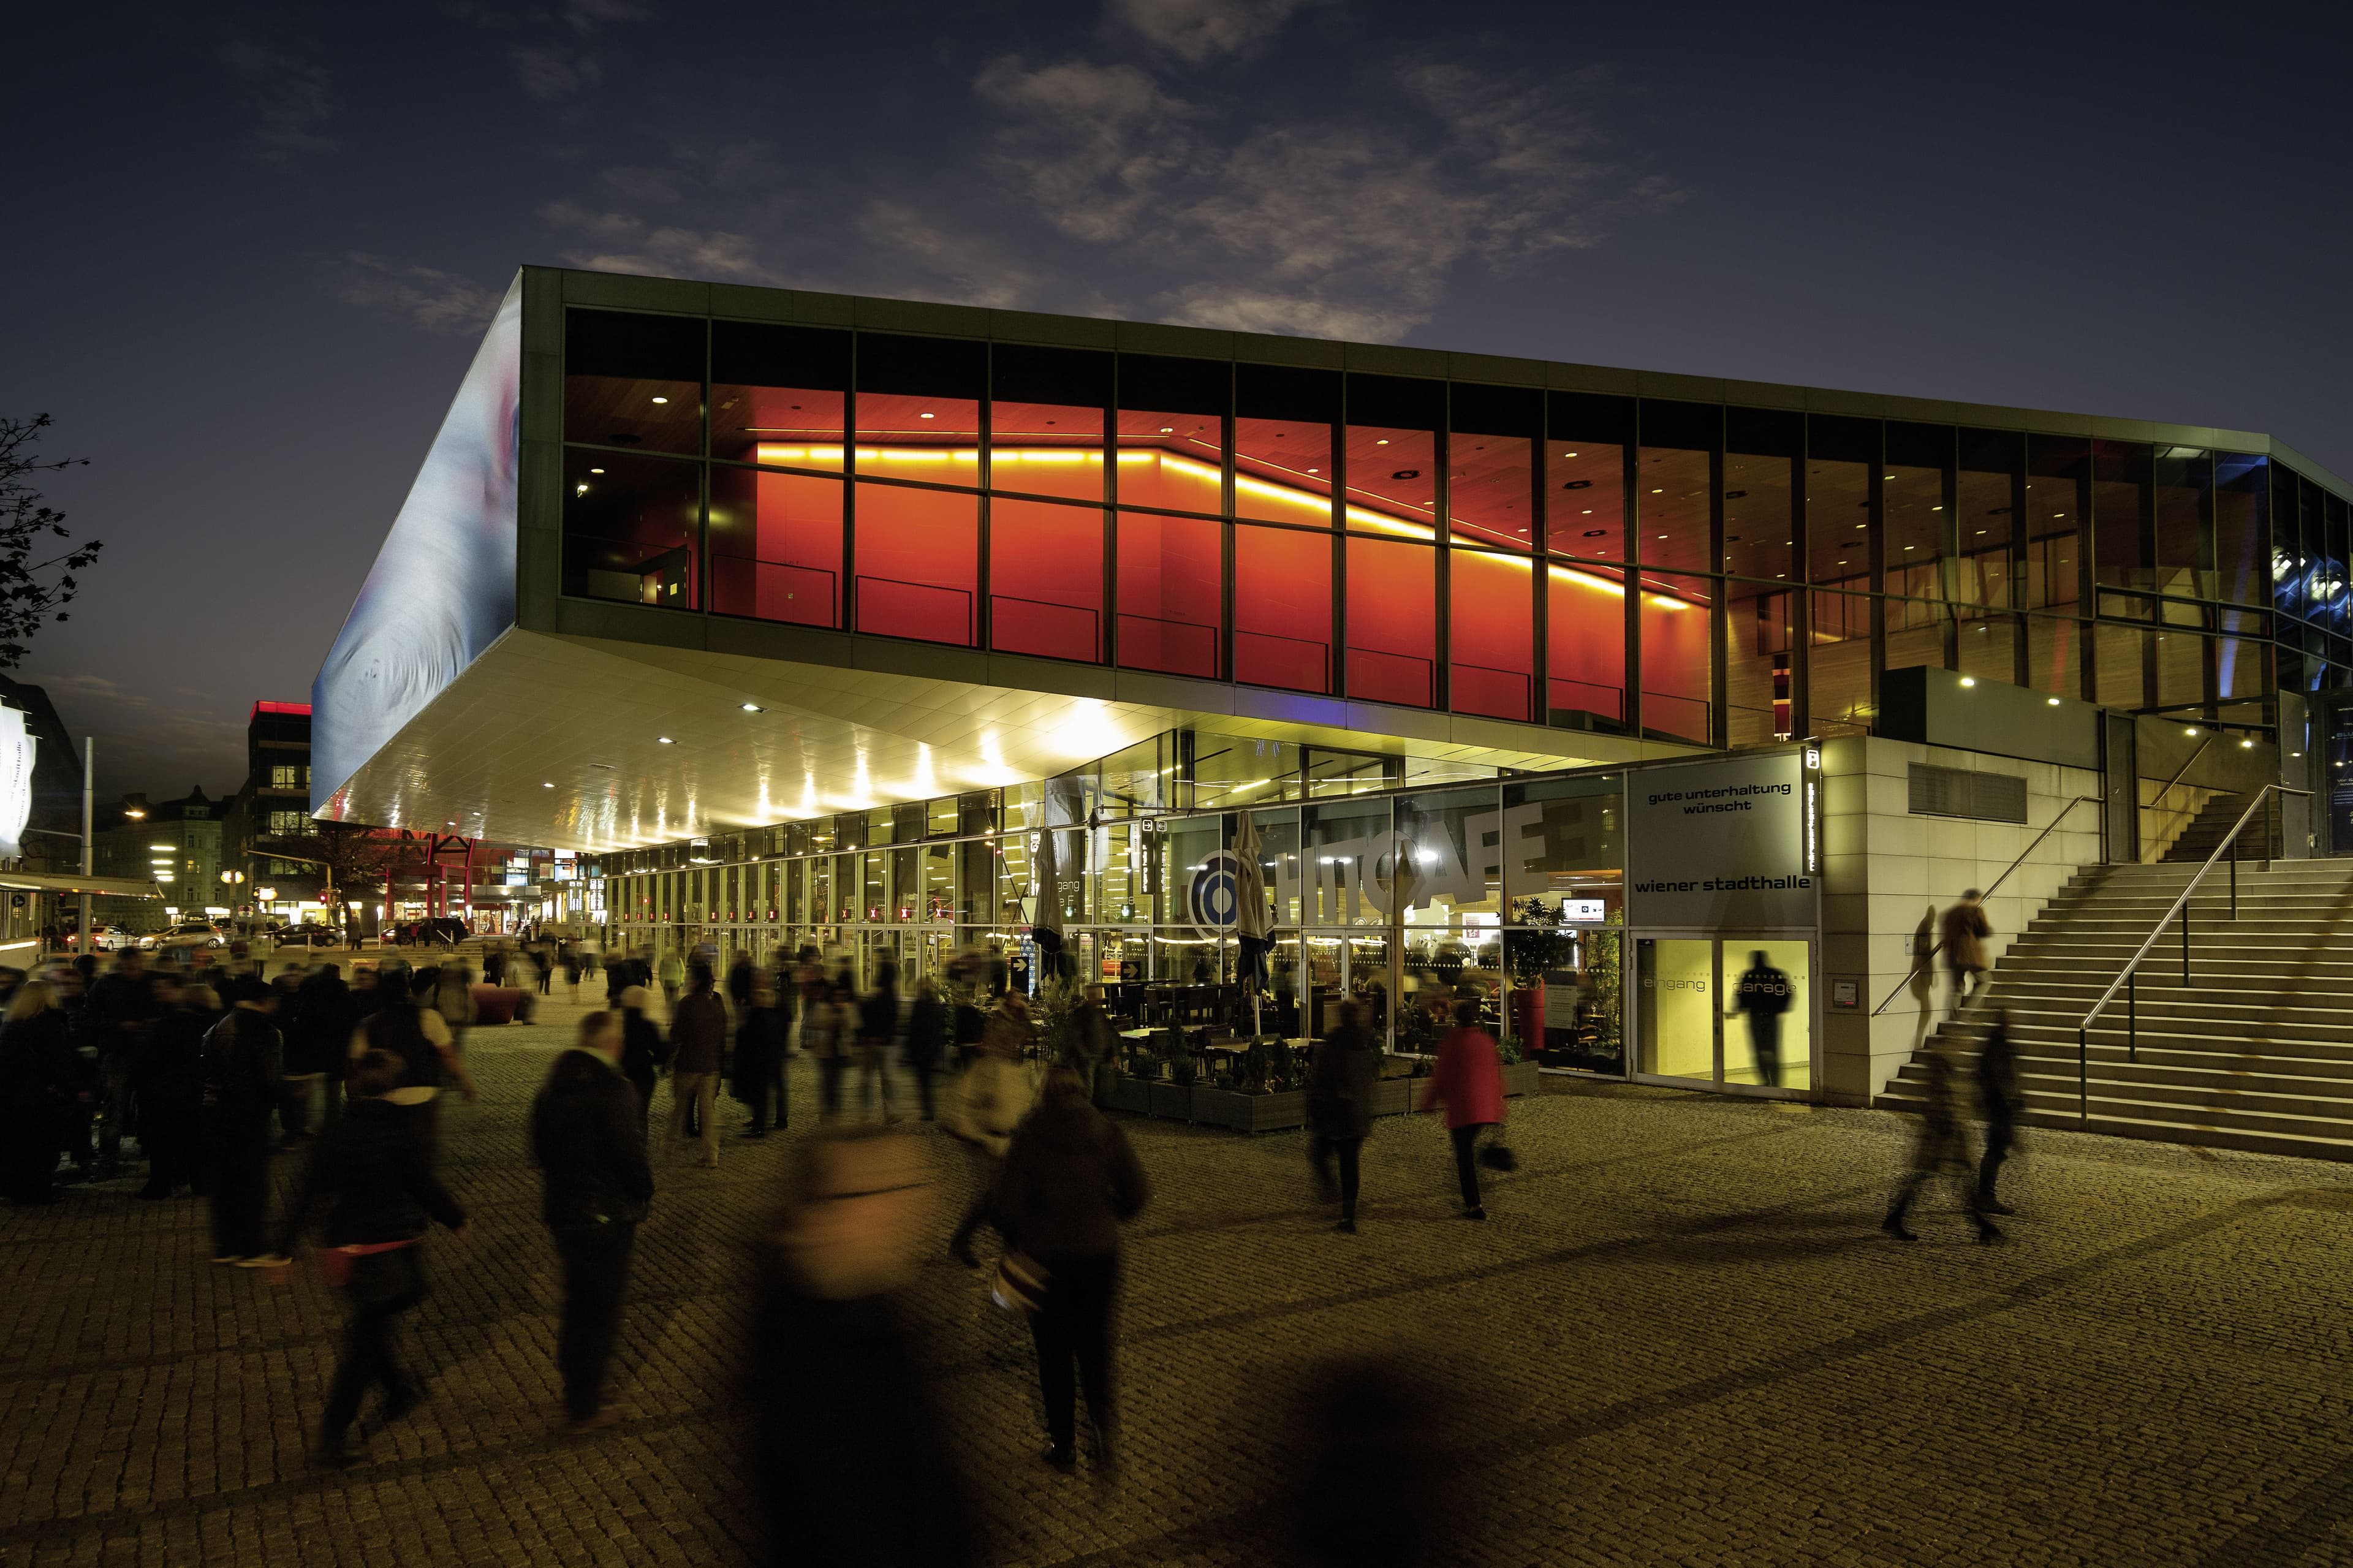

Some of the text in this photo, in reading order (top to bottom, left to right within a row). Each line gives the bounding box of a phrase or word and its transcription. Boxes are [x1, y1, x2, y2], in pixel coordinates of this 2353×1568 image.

[1648, 783, 1791, 805] gute unterhaltung
[1683, 800, 1752, 814] wünscht
[1058, 881, 1080, 892] gang
[1635, 875, 1811, 893] wiener stadthalle
[1644, 977, 1705, 992] eingang
[1733, 982, 1797, 996] garage
